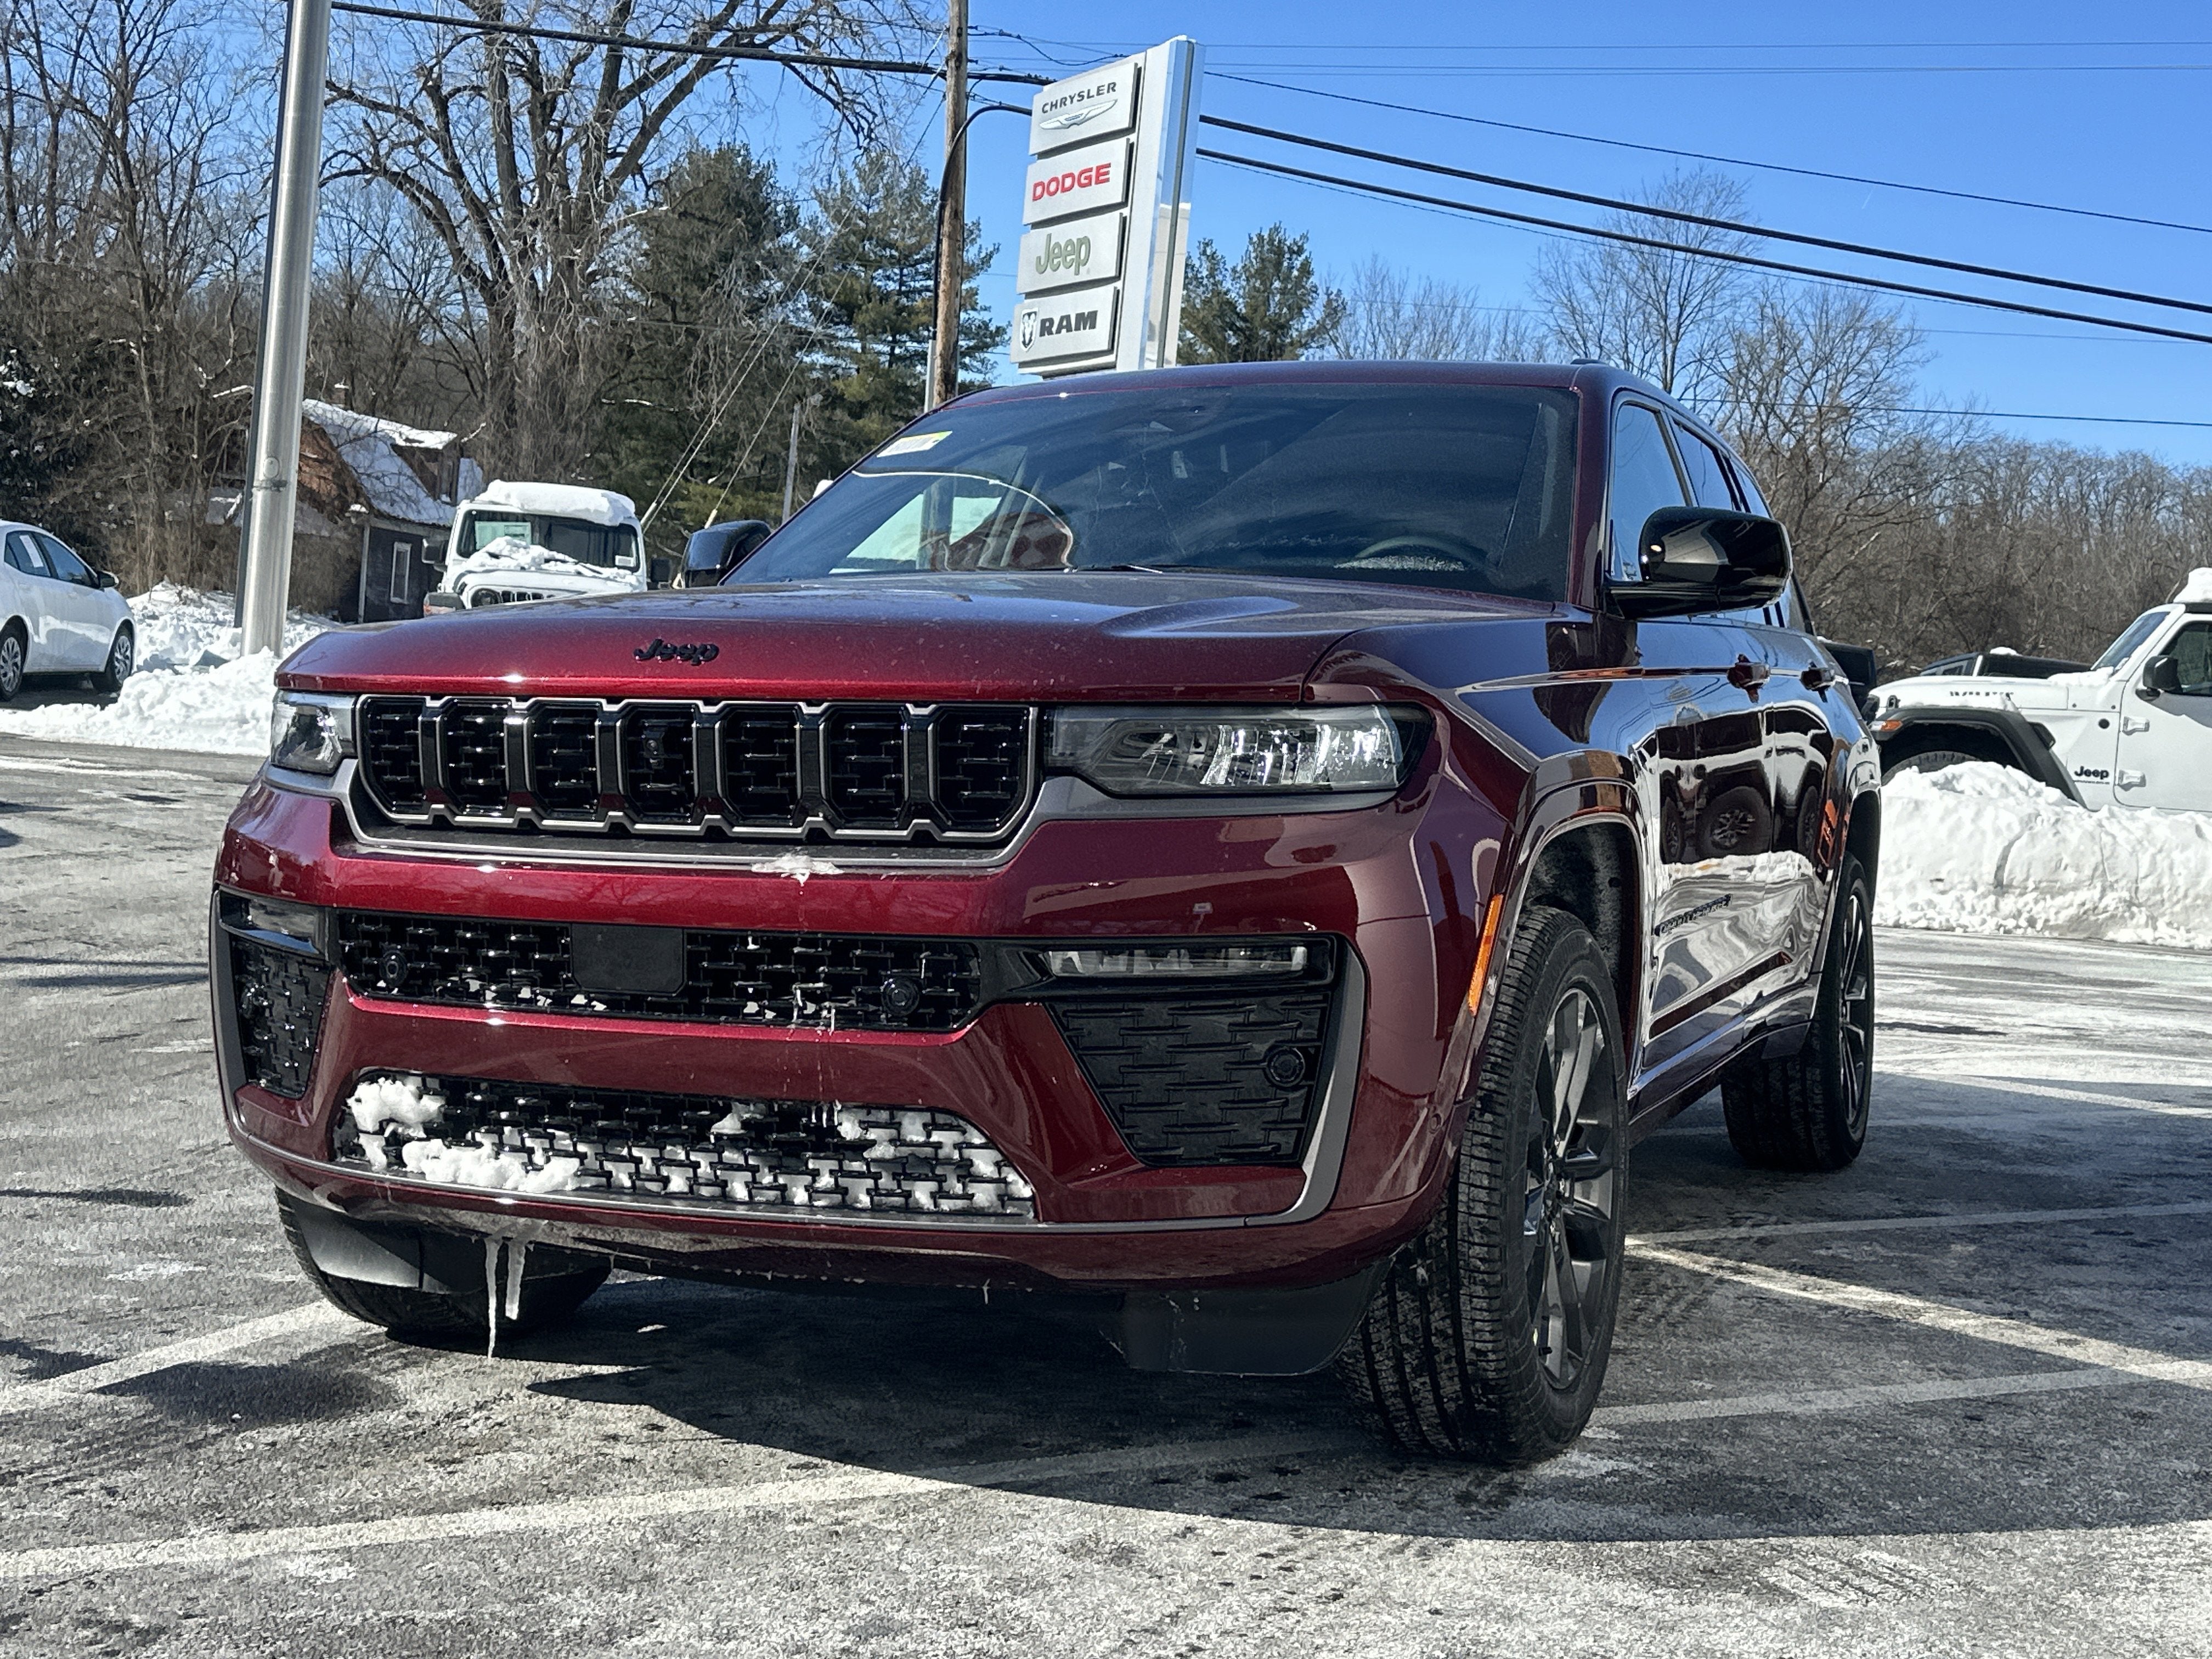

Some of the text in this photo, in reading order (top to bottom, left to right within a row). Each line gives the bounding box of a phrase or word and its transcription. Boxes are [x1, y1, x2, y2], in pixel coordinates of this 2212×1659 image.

[1042, 82, 1117, 114] CHRYSLER
[1032, 163, 1111, 201] DODGE
[1036, 233, 1091, 275] Jeep
[1039, 311, 1098, 337] RAM
[634, 639, 719, 666] Jeep
[2074, 766, 2109, 780] Jeep
